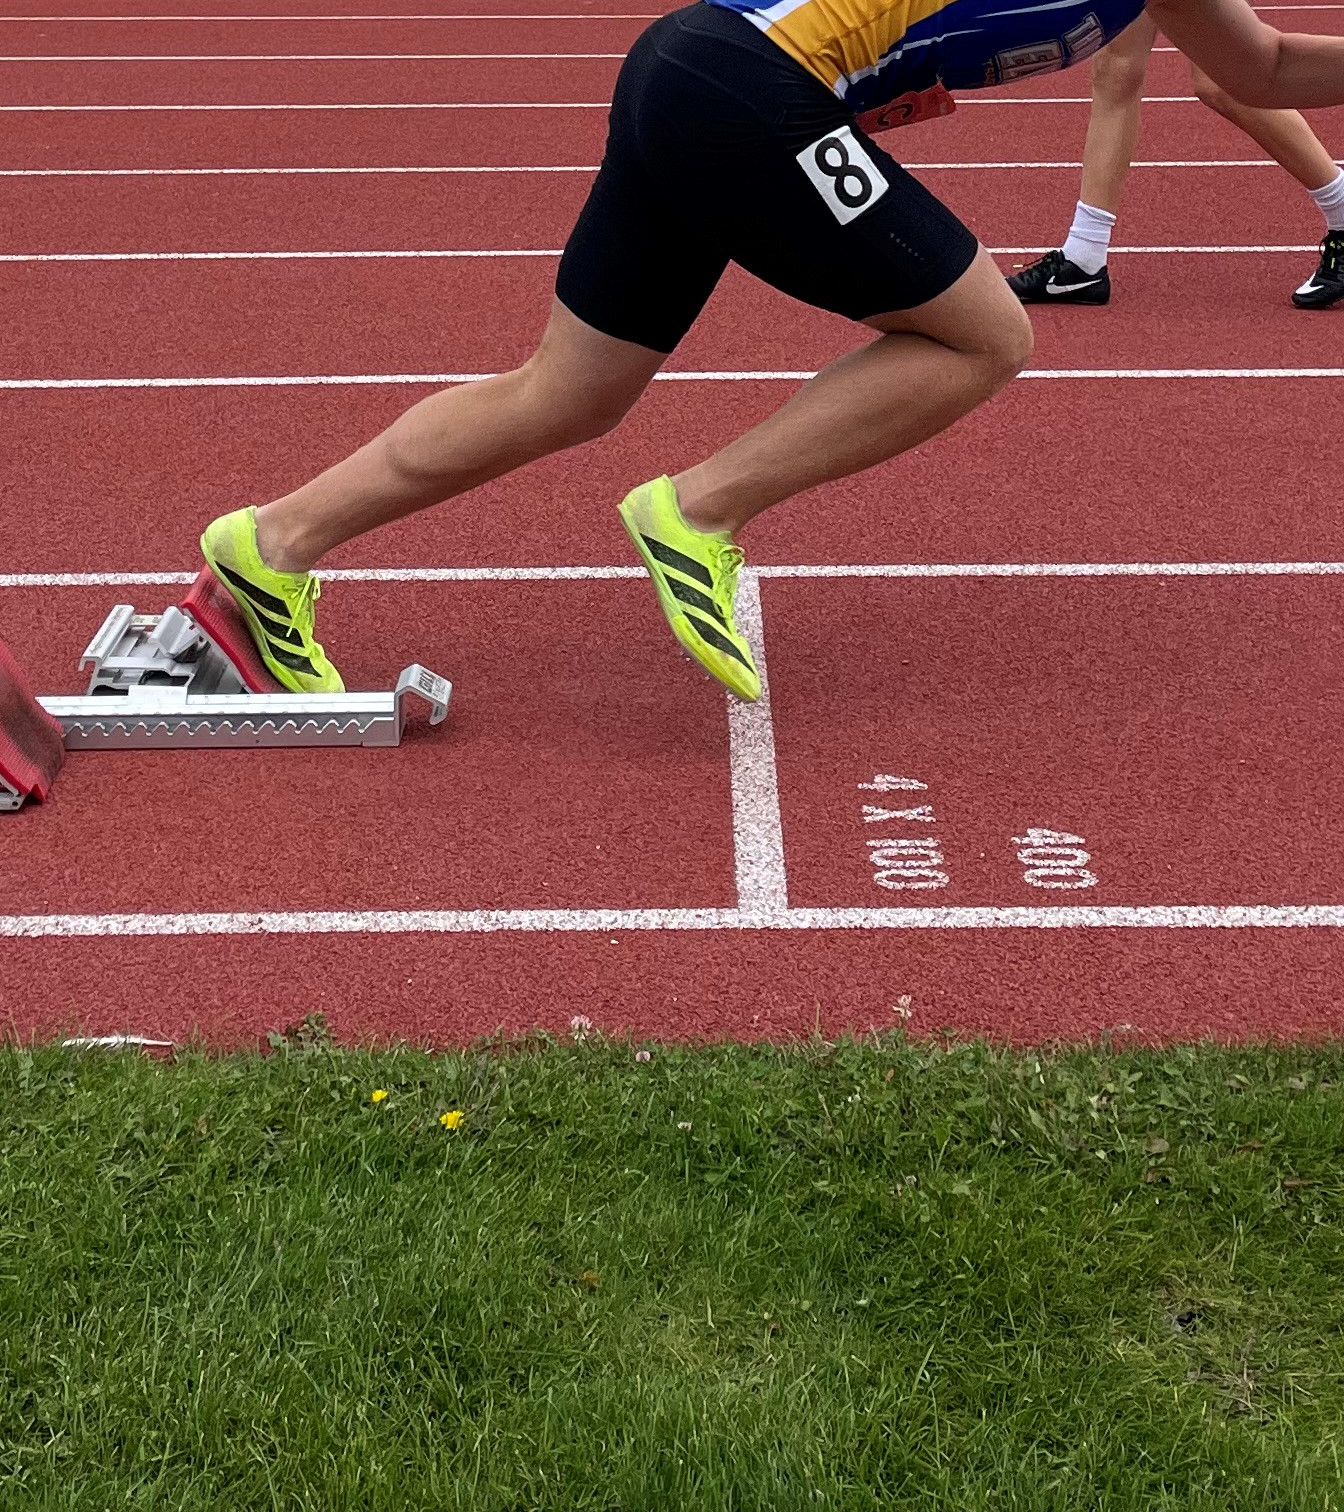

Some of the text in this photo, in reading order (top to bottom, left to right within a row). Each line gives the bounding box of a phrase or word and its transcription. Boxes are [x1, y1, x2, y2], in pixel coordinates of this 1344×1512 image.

[814, 135, 873, 209] 8
[857, 774, 928, 791] 4
[866, 836, 950, 889] 100
[1010, 827, 1099, 889] 400
